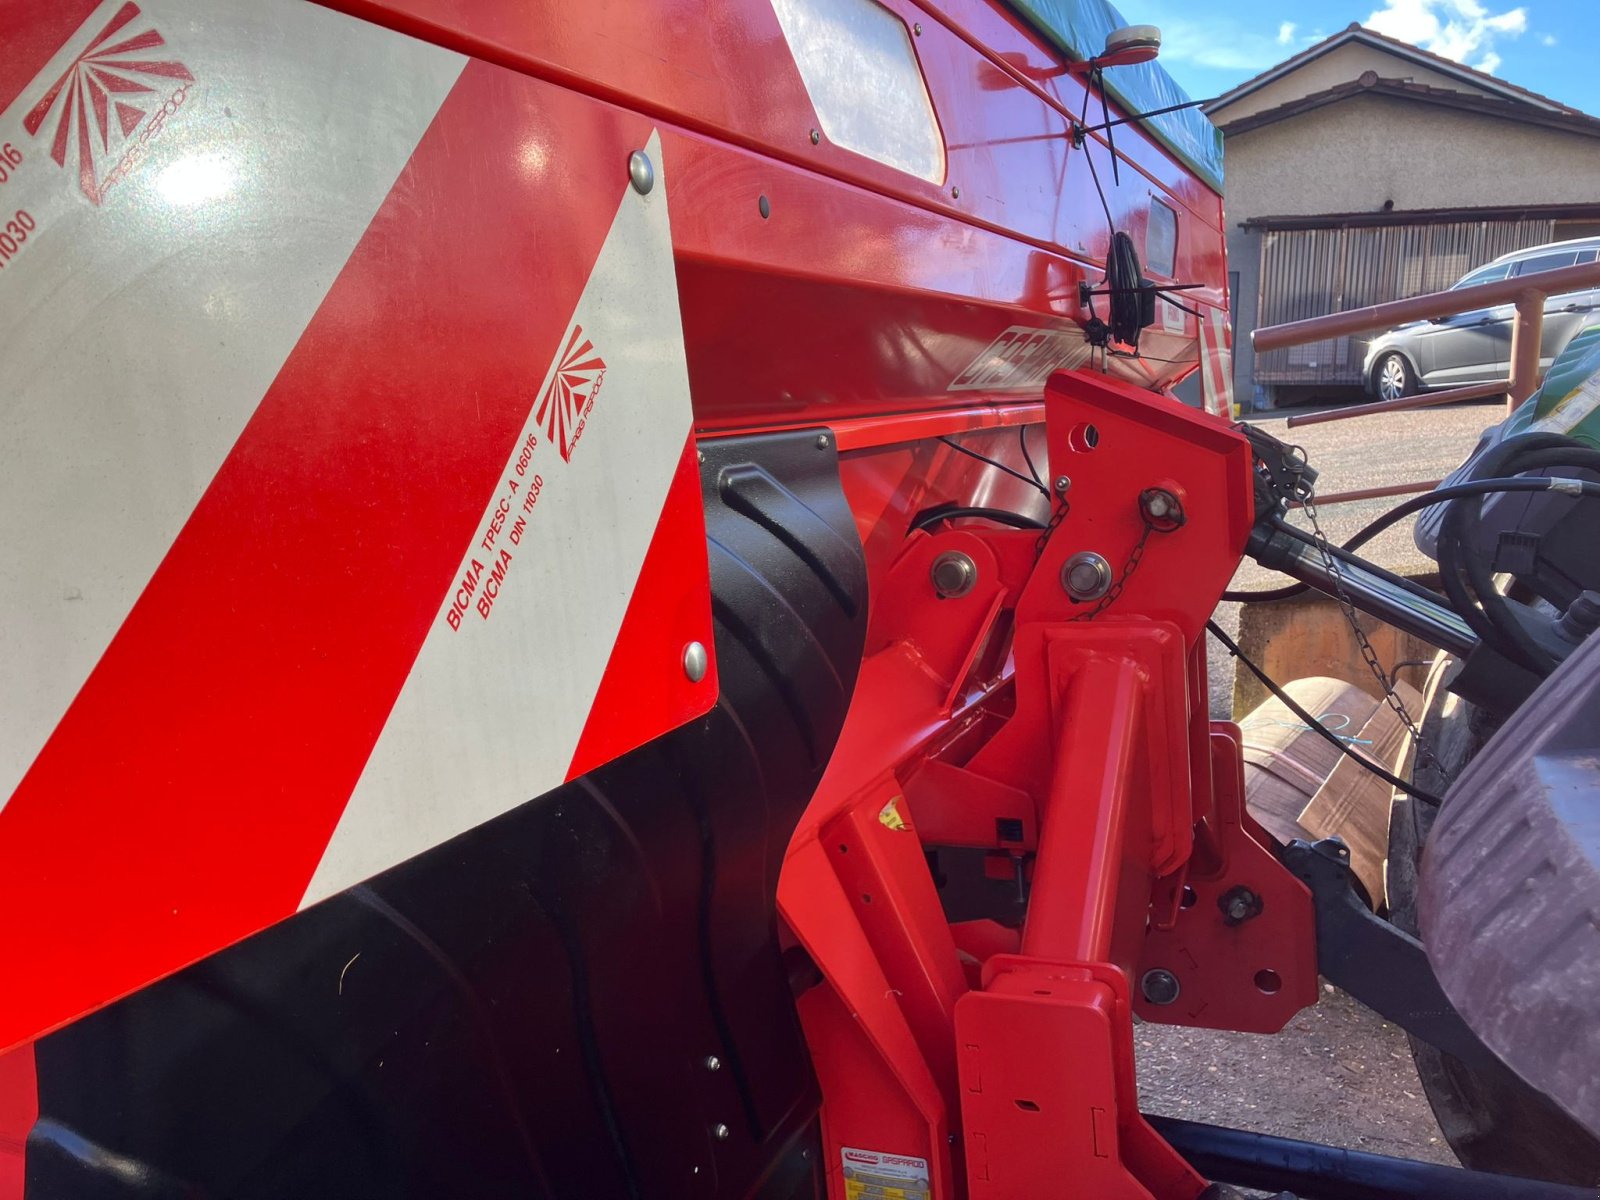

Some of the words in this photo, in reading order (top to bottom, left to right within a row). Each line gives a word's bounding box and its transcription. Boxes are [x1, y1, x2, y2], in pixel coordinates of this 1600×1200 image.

[0, 210, 35, 268] 1030
[446, 558, 485, 632] BICMA
[515, 433, 538, 477] 06016
[476, 549, 513, 620] BICMA
[509, 515, 527, 546] DIN
[523, 474, 544, 515] 11030
